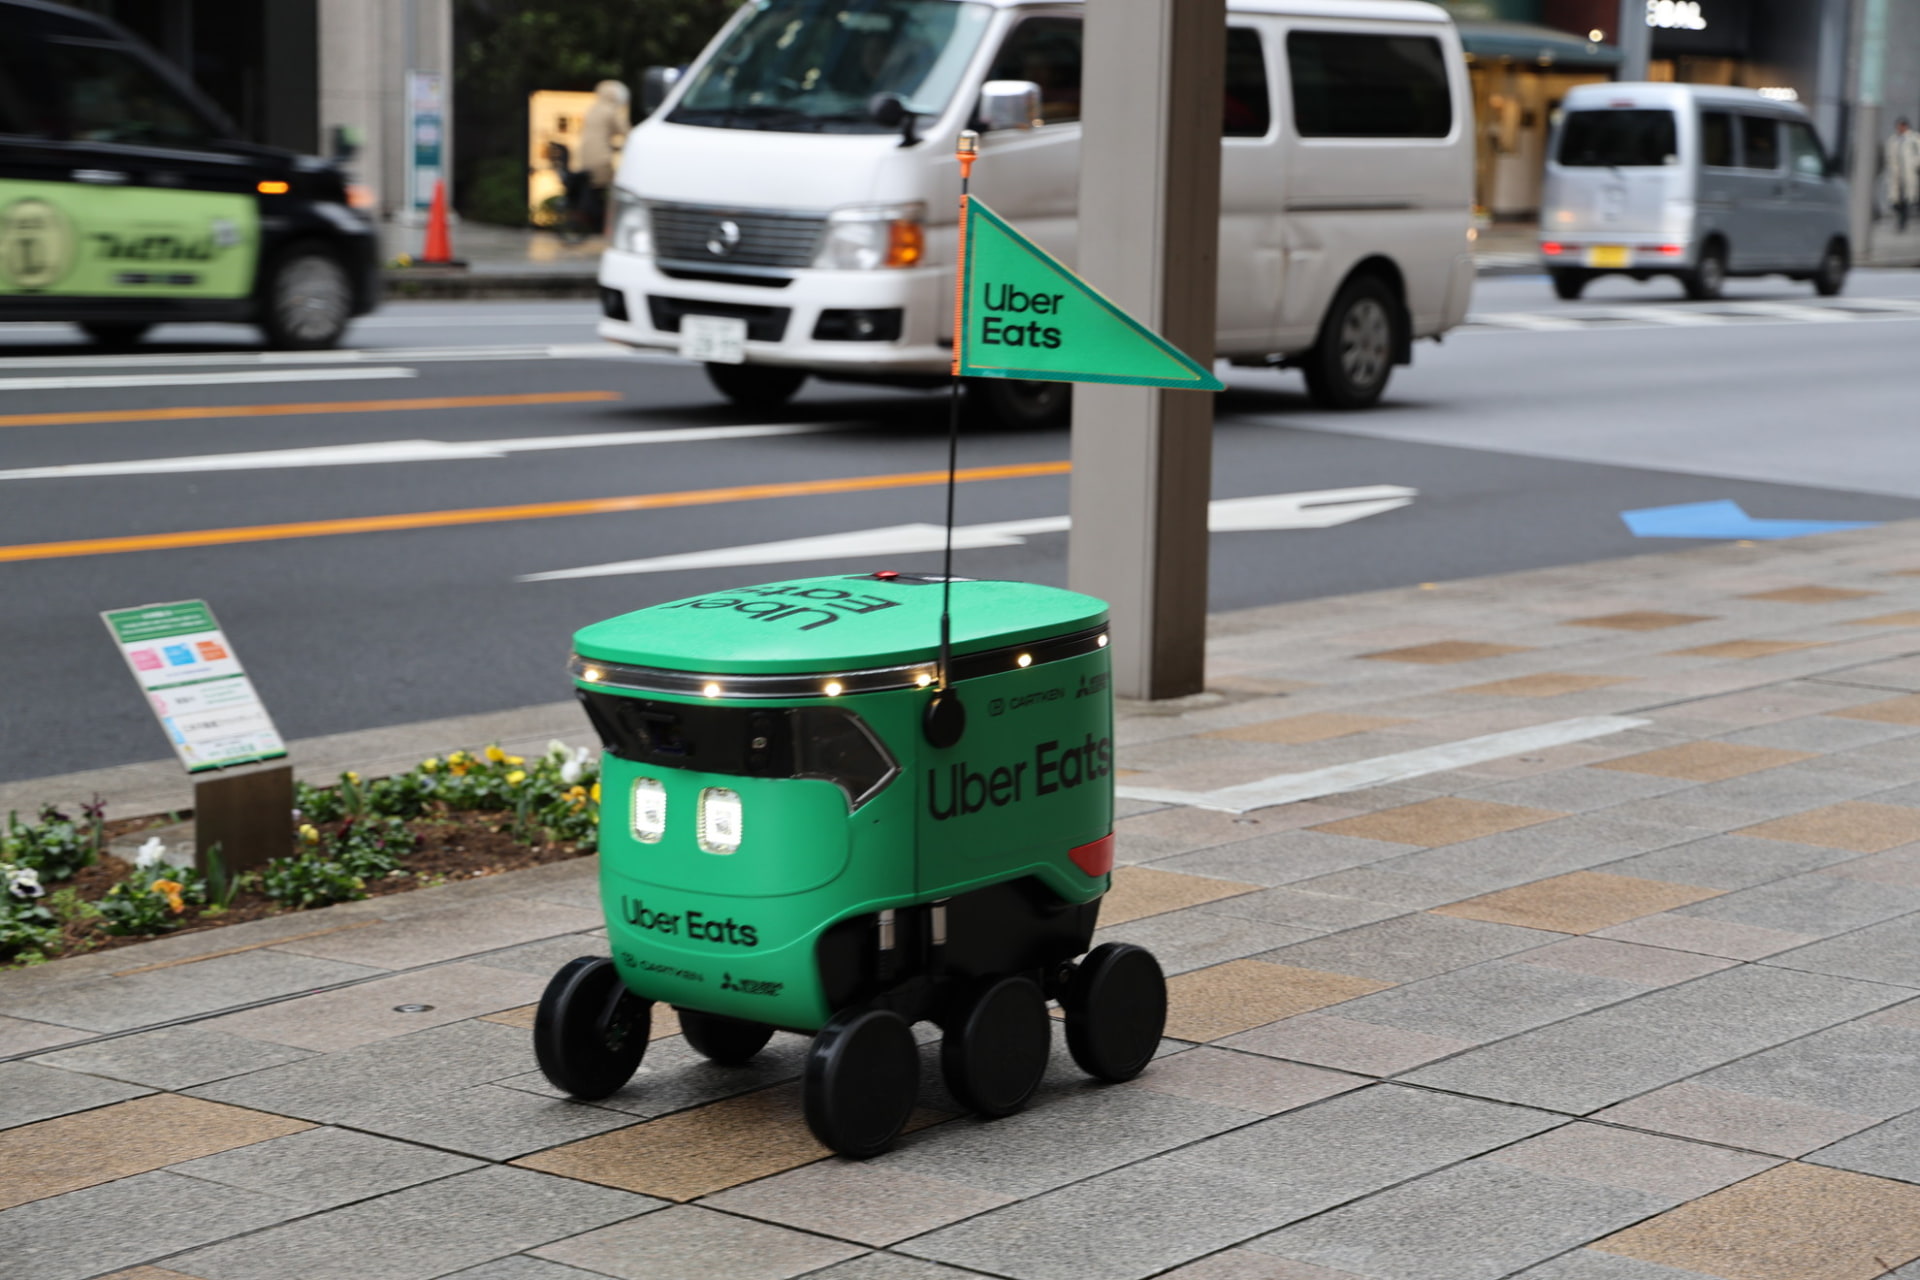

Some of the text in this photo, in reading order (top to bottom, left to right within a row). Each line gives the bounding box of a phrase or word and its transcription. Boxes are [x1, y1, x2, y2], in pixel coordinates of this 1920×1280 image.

[983, 282, 1065, 315] Uber
[982, 316, 1062, 349] Eats
[659, 598, 840, 631] Uber
[928, 732, 1111, 821] Uber Eats
[621, 895, 759, 947] Uber Eats
